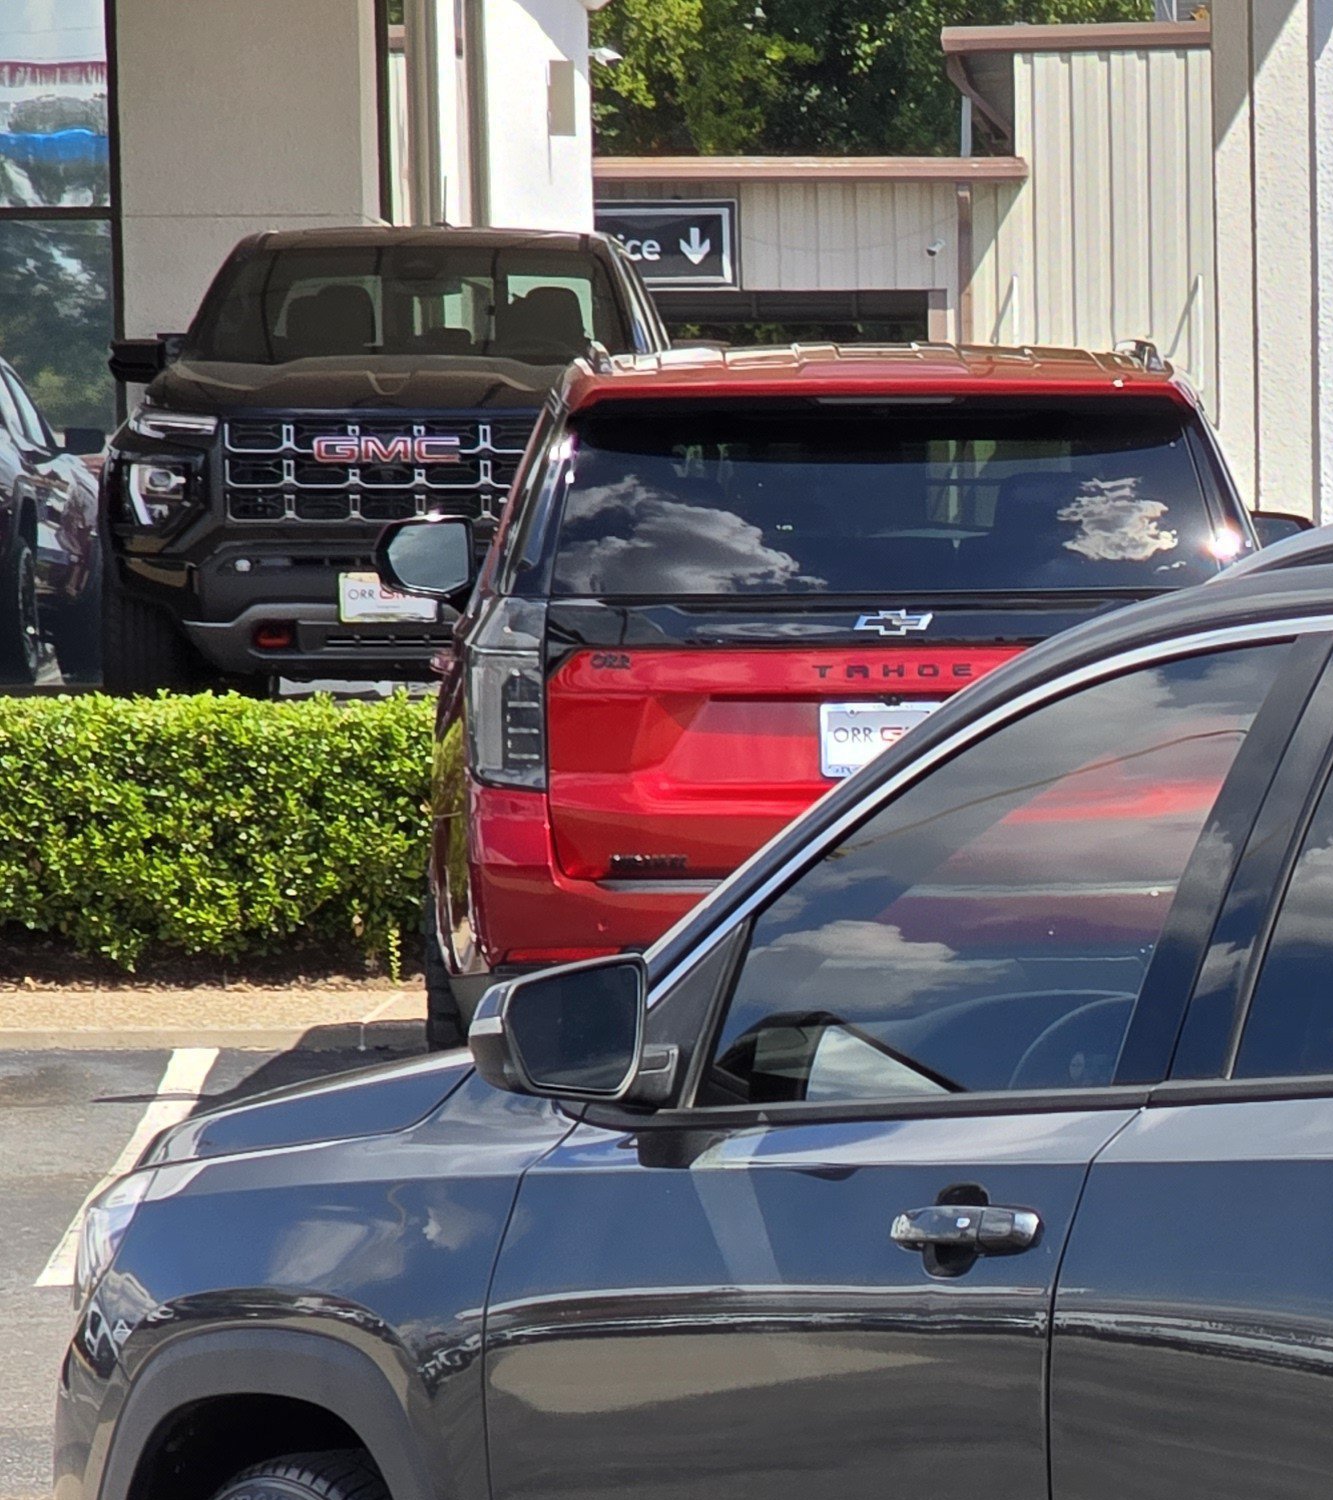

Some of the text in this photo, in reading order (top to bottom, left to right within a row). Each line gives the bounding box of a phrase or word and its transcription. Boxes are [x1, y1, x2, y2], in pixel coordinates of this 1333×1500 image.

[312, 435, 461, 464] GMC
[347, 588, 376, 600] ORR
[590, 653, 631, 670] ORR
[812, 663, 973, 679] TAHOE
[833, 727, 873, 743] ORR
